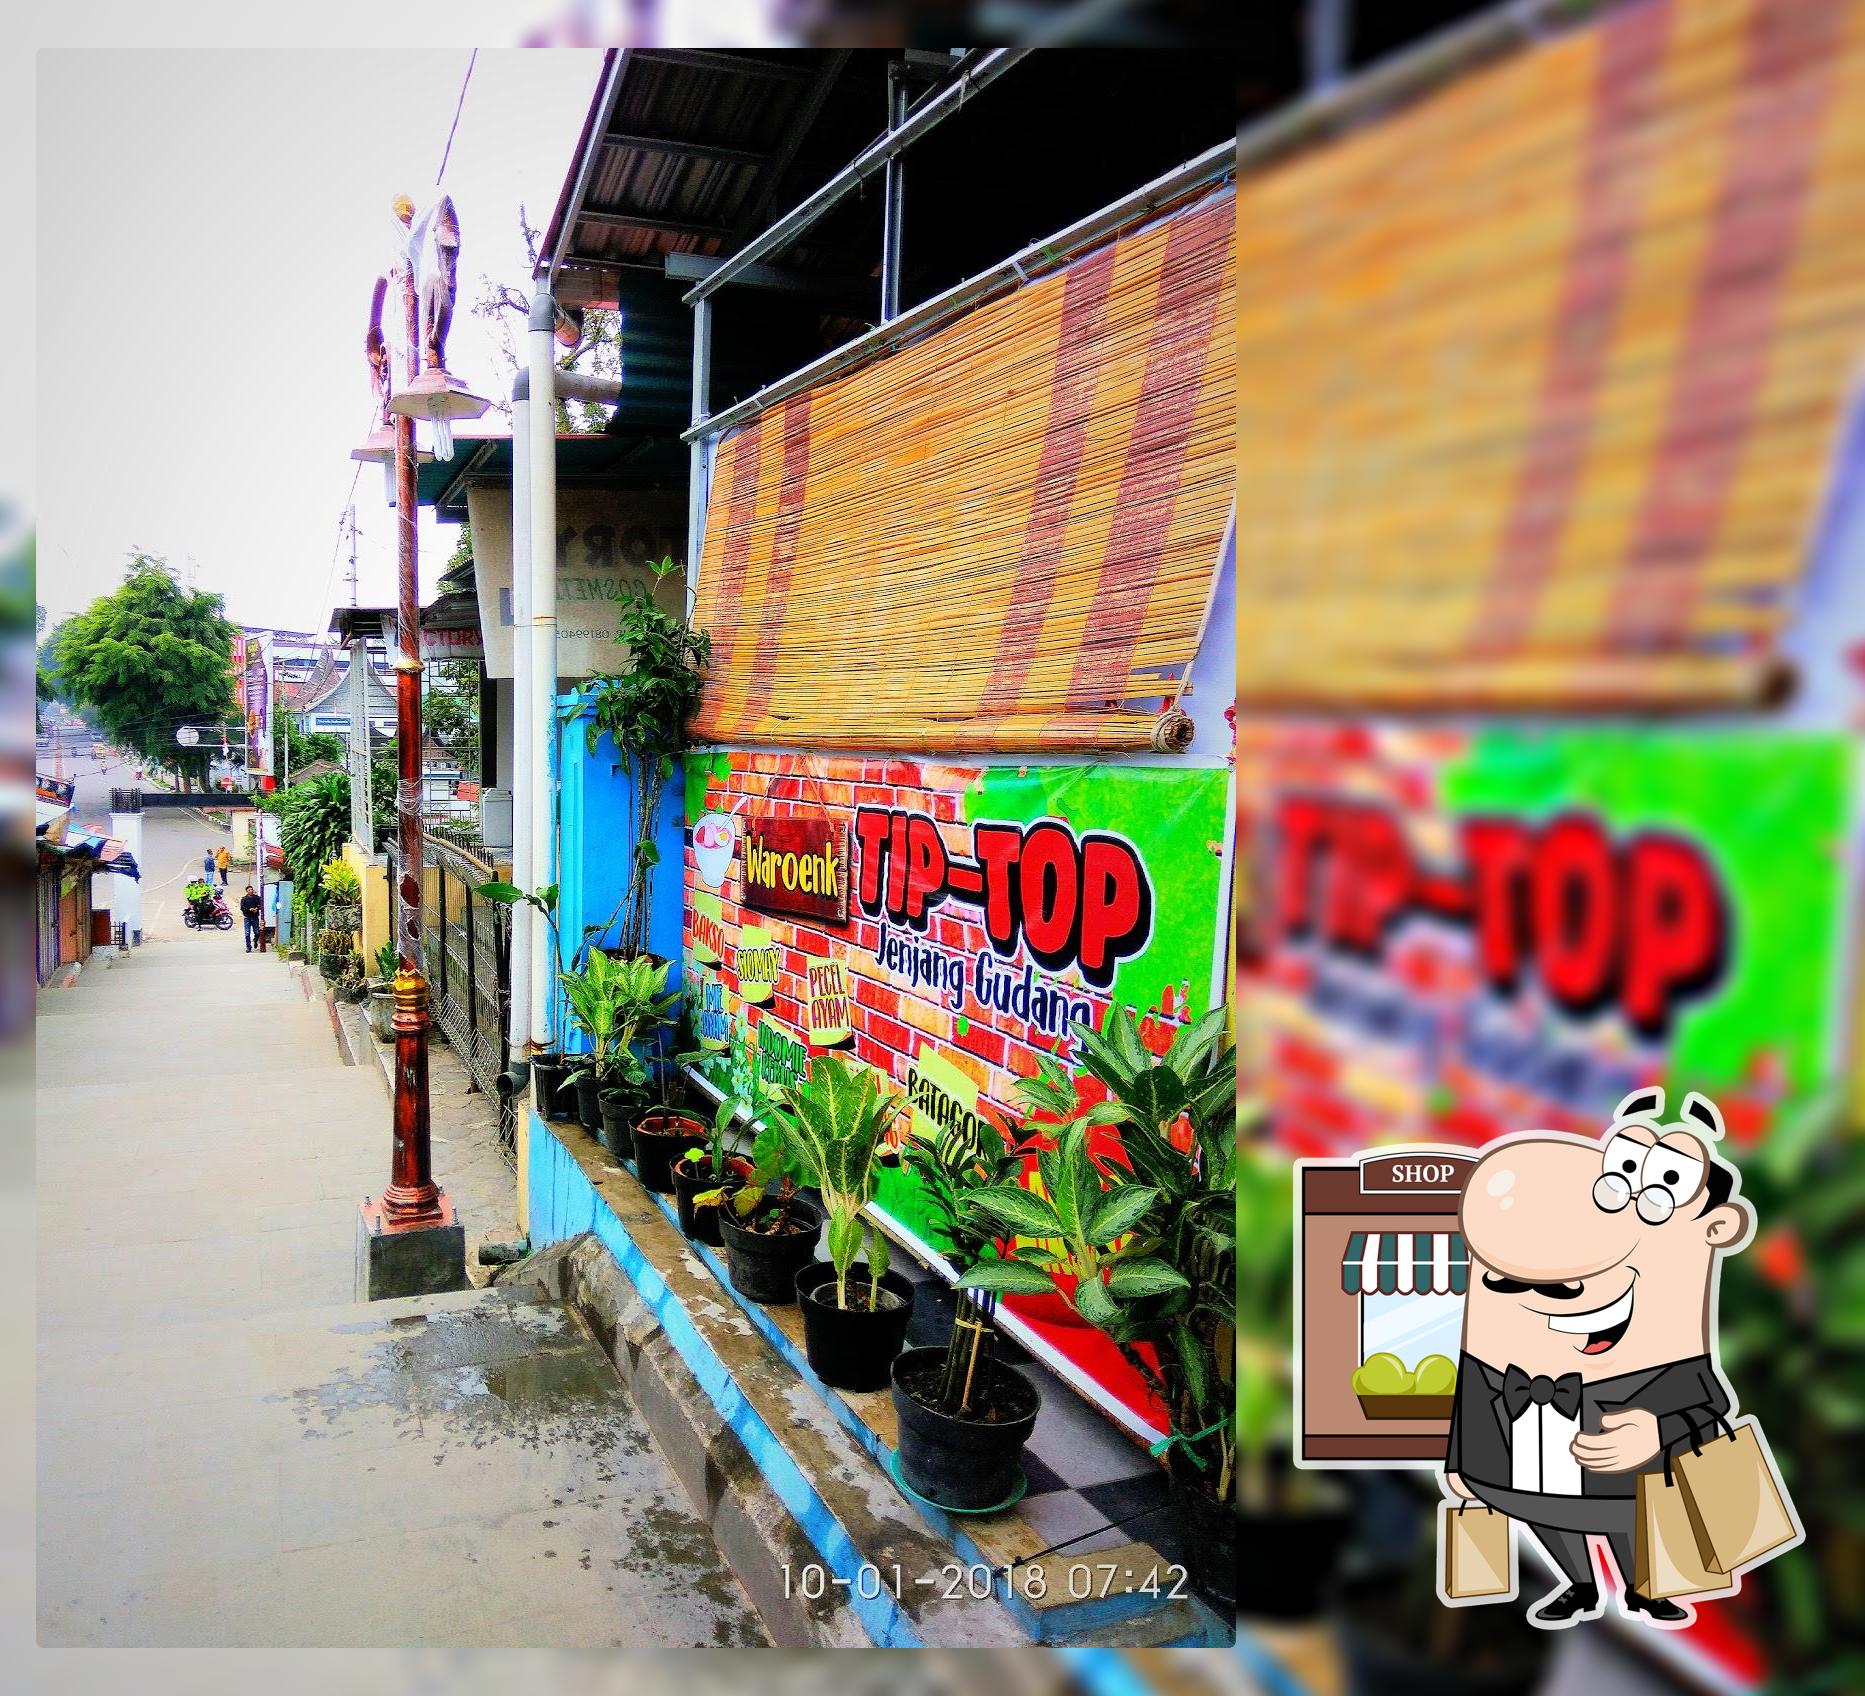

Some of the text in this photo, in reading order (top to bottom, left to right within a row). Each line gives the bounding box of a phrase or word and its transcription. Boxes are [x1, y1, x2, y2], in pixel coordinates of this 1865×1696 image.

[746, 835, 838, 898] Waroenk
[855, 806, 1155, 990] TIP-TOP
[691, 908, 725, 960] BAKSO
[736, 948, 781, 984] SIOMAY
[808, 963, 846, 998] PECEL
[875, 920, 1092, 1055] Jenjang Gudang
[705, 982, 723, 1010] MIE
[811, 996, 850, 1029] AYAM
